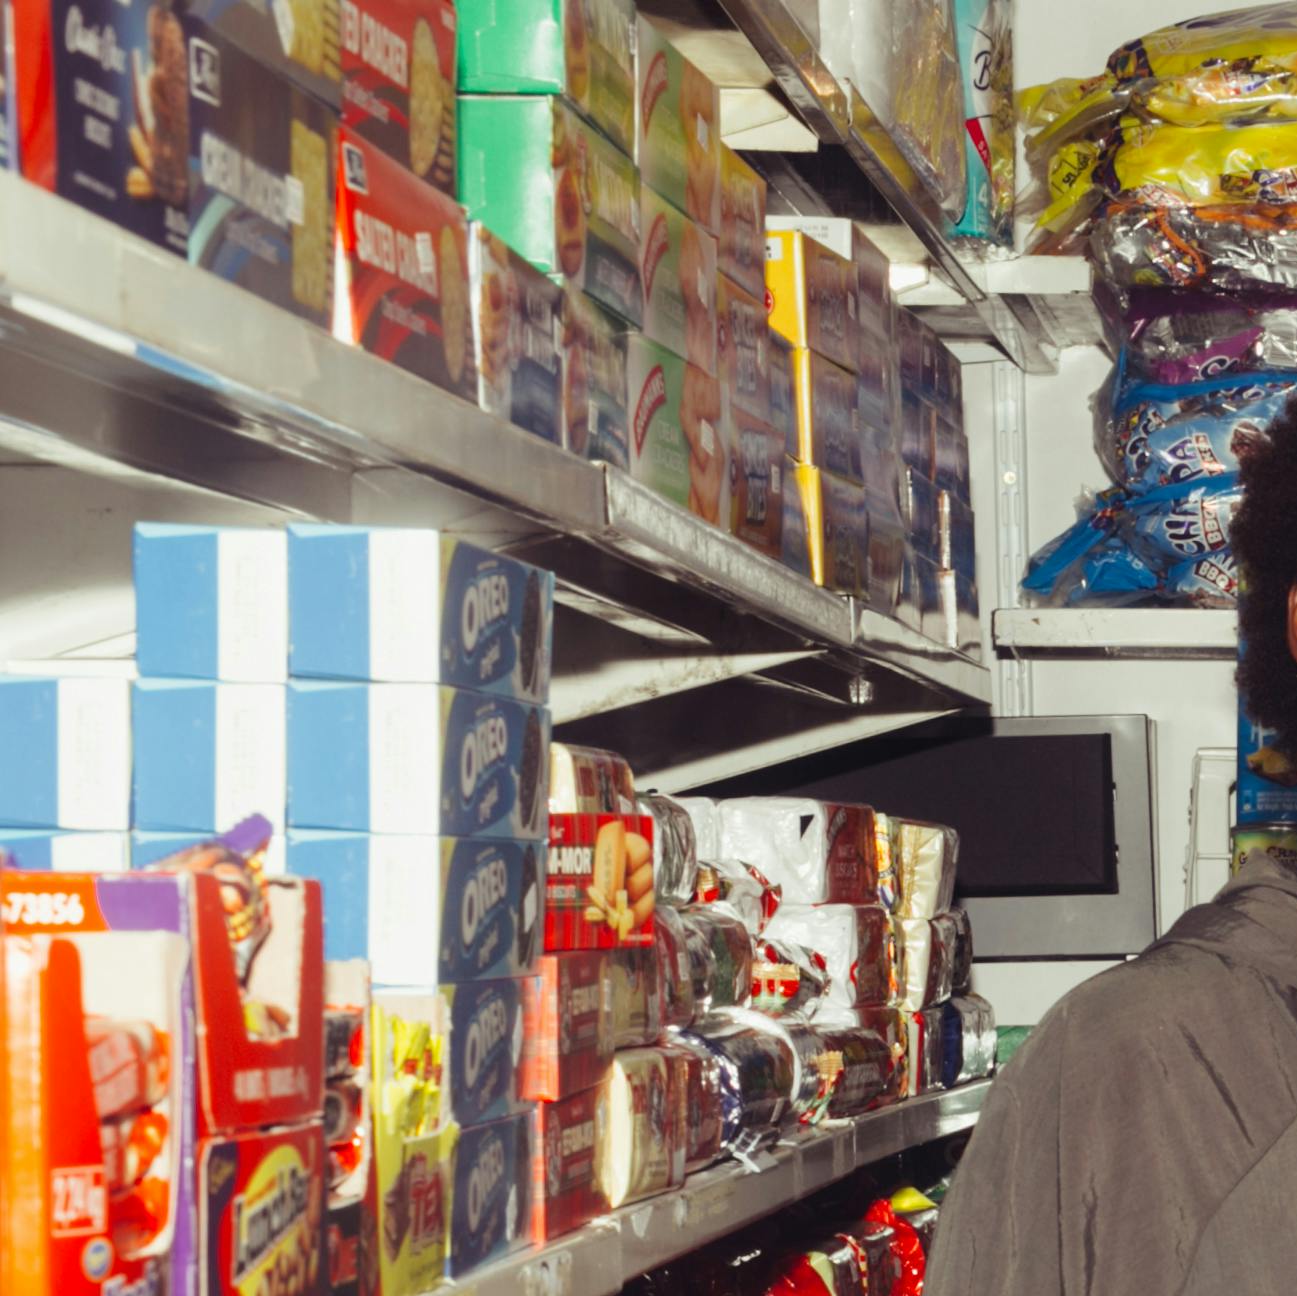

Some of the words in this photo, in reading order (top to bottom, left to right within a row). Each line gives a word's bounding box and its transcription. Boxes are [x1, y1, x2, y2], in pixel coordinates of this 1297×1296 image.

[462, 575, 510, 652] OREO
[461, 716, 508, 800] OREO
[461, 858, 508, 946] OREO
[464, 1002, 505, 1088] OREO
[467, 1142, 503, 1230] OREO
